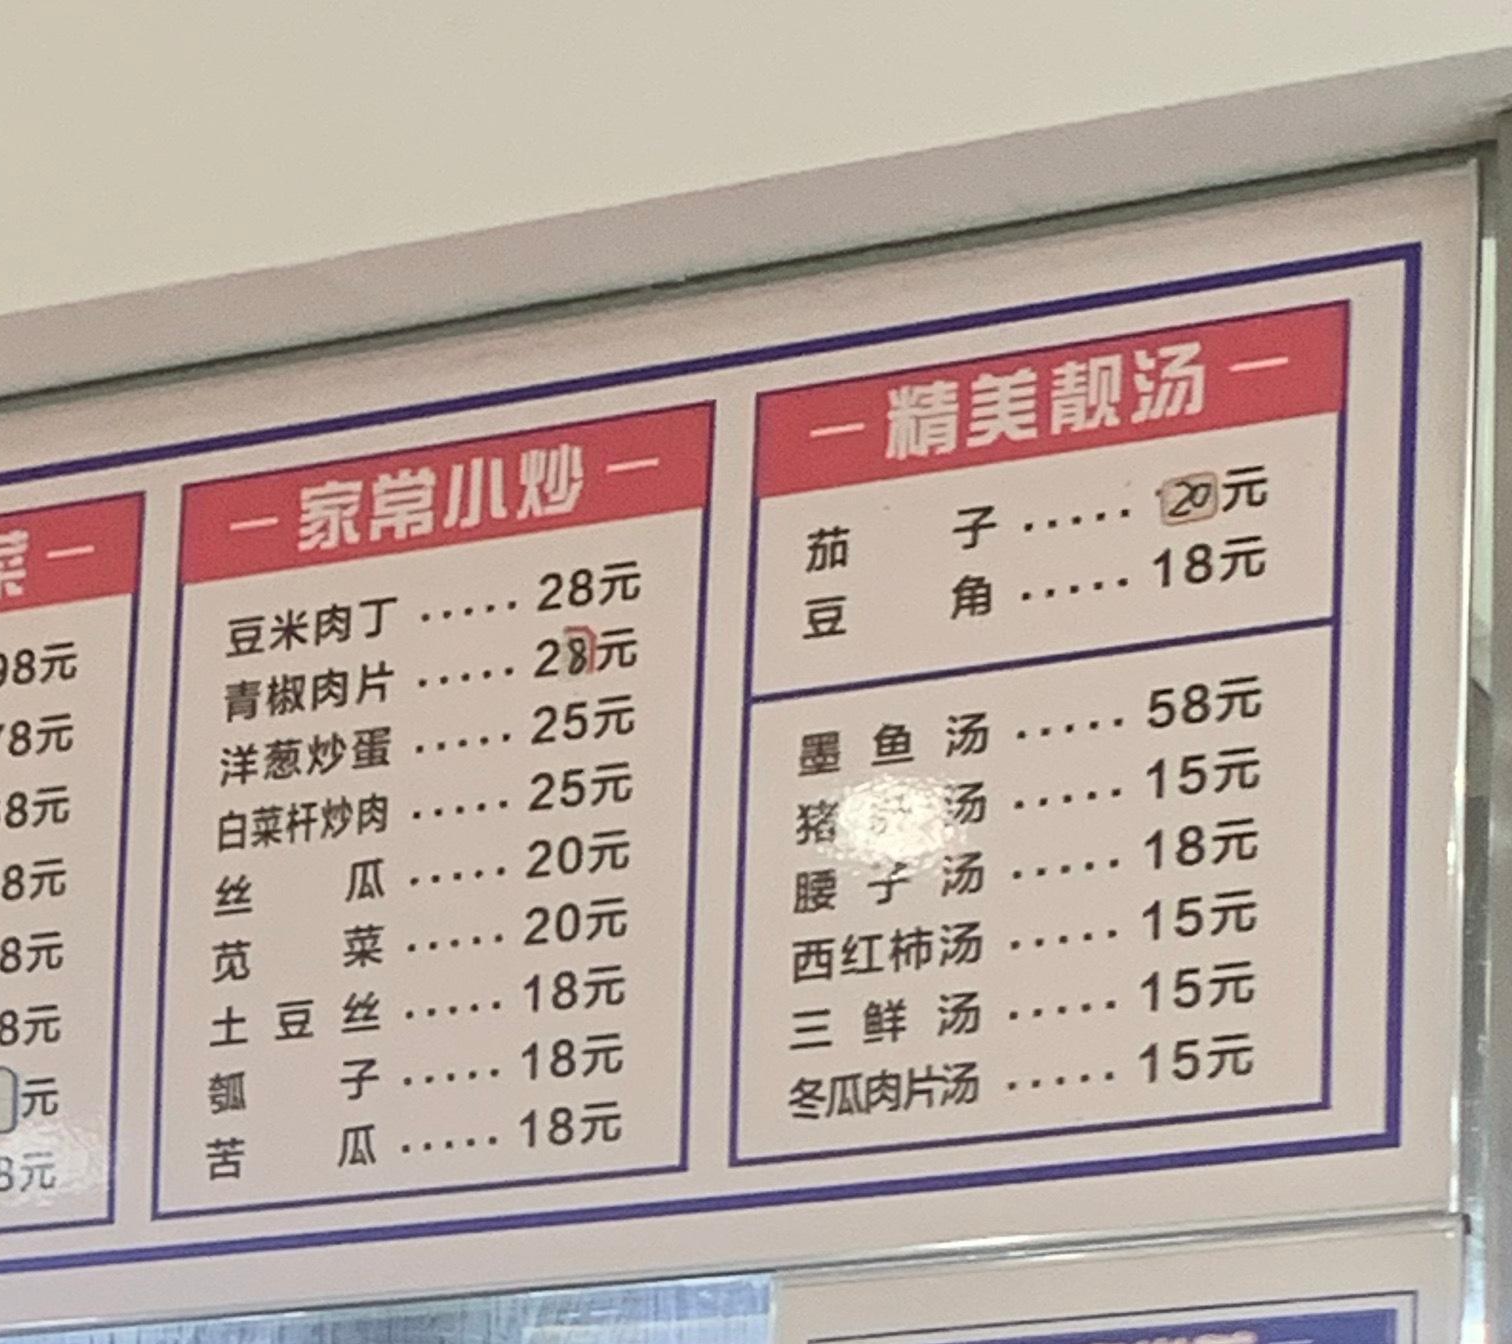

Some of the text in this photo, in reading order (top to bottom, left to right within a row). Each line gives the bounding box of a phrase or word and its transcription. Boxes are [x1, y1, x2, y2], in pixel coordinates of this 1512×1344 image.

[885, 340, 1205, 462] 精美靓汤
[297, 442, 585, 553] 家常小炒
[806, 504, 998, 574] 茄子
[227, 561, 642, 658] 豆米肉丁 28元
[802, 535, 1267, 641] 豆角 18元
[225, 627, 639, 724] 青椒肉片 28元
[220, 695, 636, 787] 洋葱炒蛋 25元
[798, 674, 1263, 777] 墨鱼汤 58元
[217, 761, 634, 853] 白菜杆炒肉 25元
[796, 746, 1261, 846] 猪汤 15元
[526, 830, 631, 880] 20元
[1144, 817, 1260, 870] 18元
[524, 897, 628, 946] 20元
[792, 889, 1258, 986] 西红柿汤 15元
[210, 964, 626, 1048] 土豆丝 18元
[789, 960, 1256, 1053] 三鲜汤 15元
[521, 1032, 624, 1081] 18元
[788, 1031, 1255, 1123] 冬瓜肉片汤 15元
[519, 1100, 623, 1149] 18元
